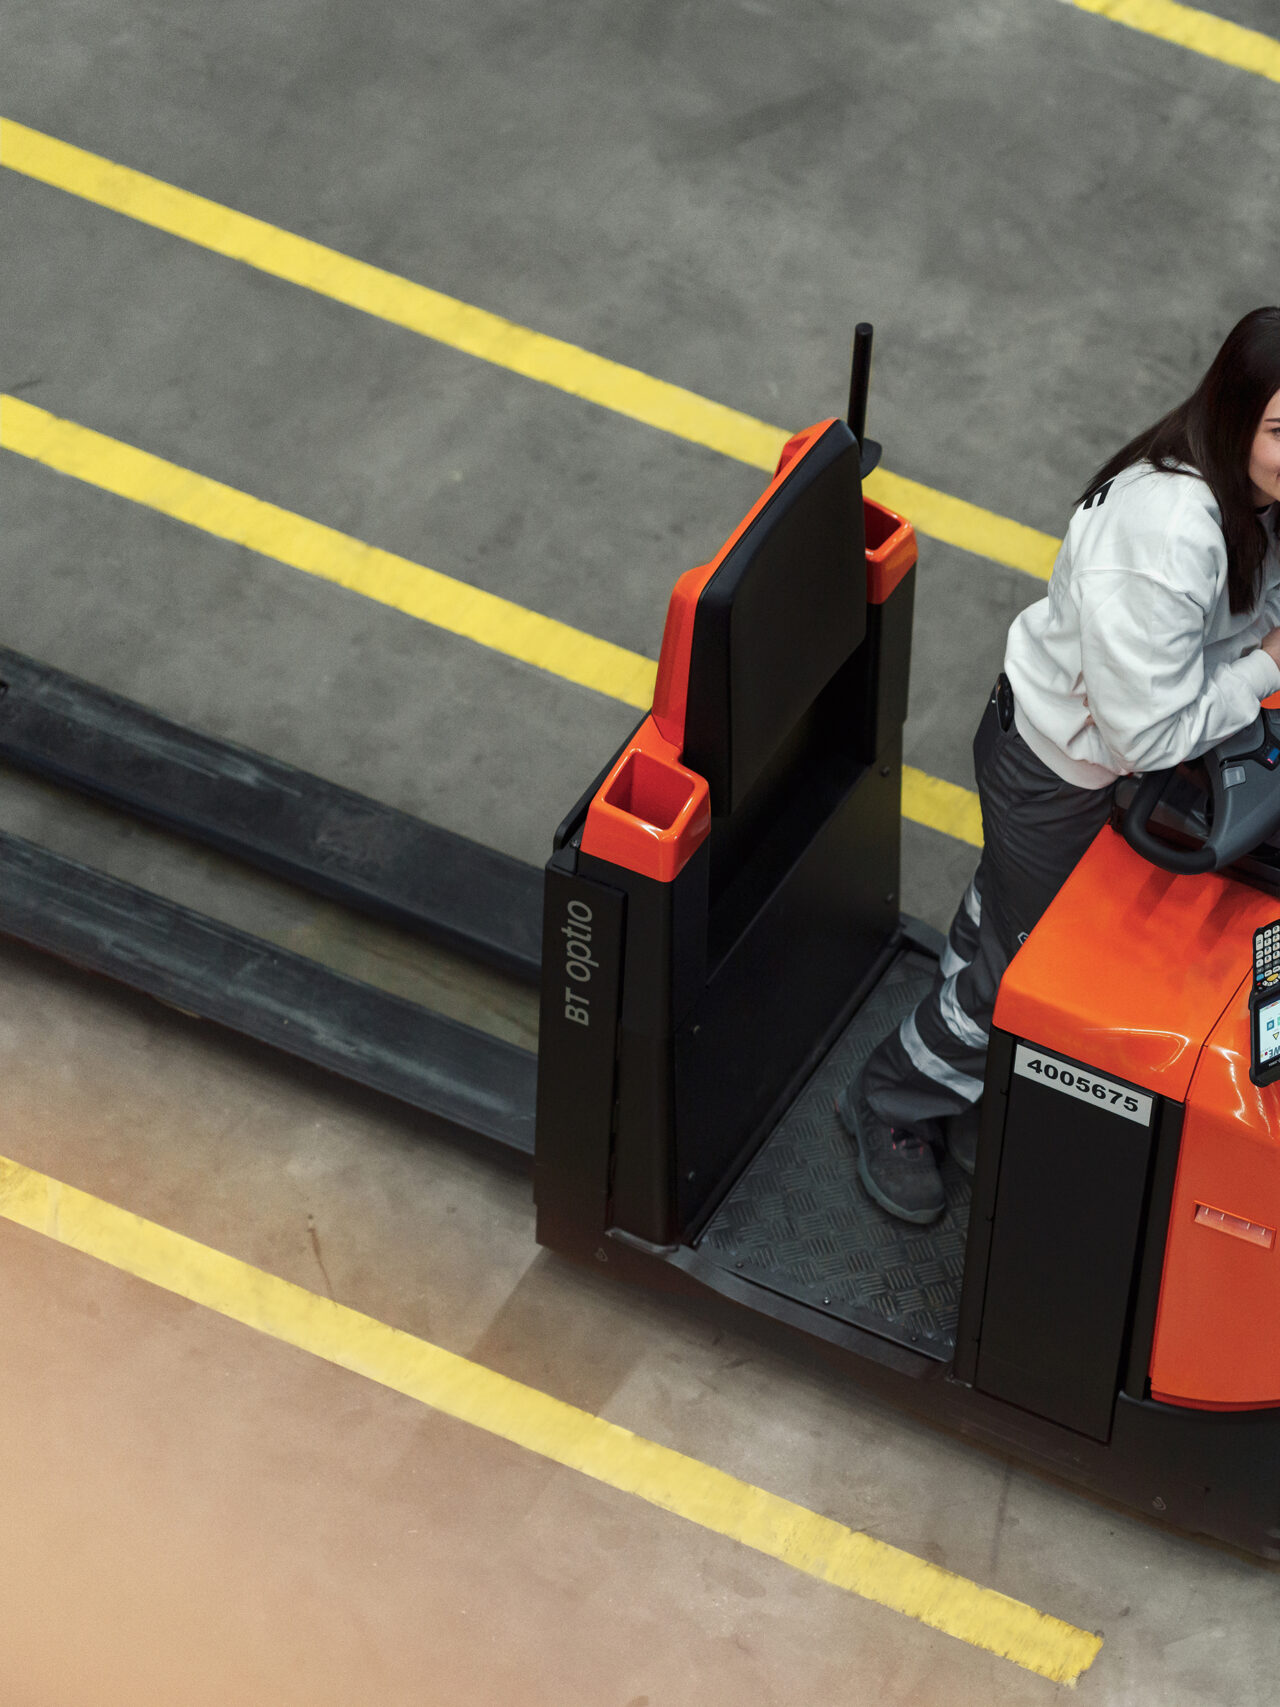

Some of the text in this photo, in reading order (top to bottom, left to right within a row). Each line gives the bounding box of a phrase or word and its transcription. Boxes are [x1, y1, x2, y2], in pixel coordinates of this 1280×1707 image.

[560, 900, 599, 1026] BT optio
[1026, 1058, 1140, 1113] 4005675
